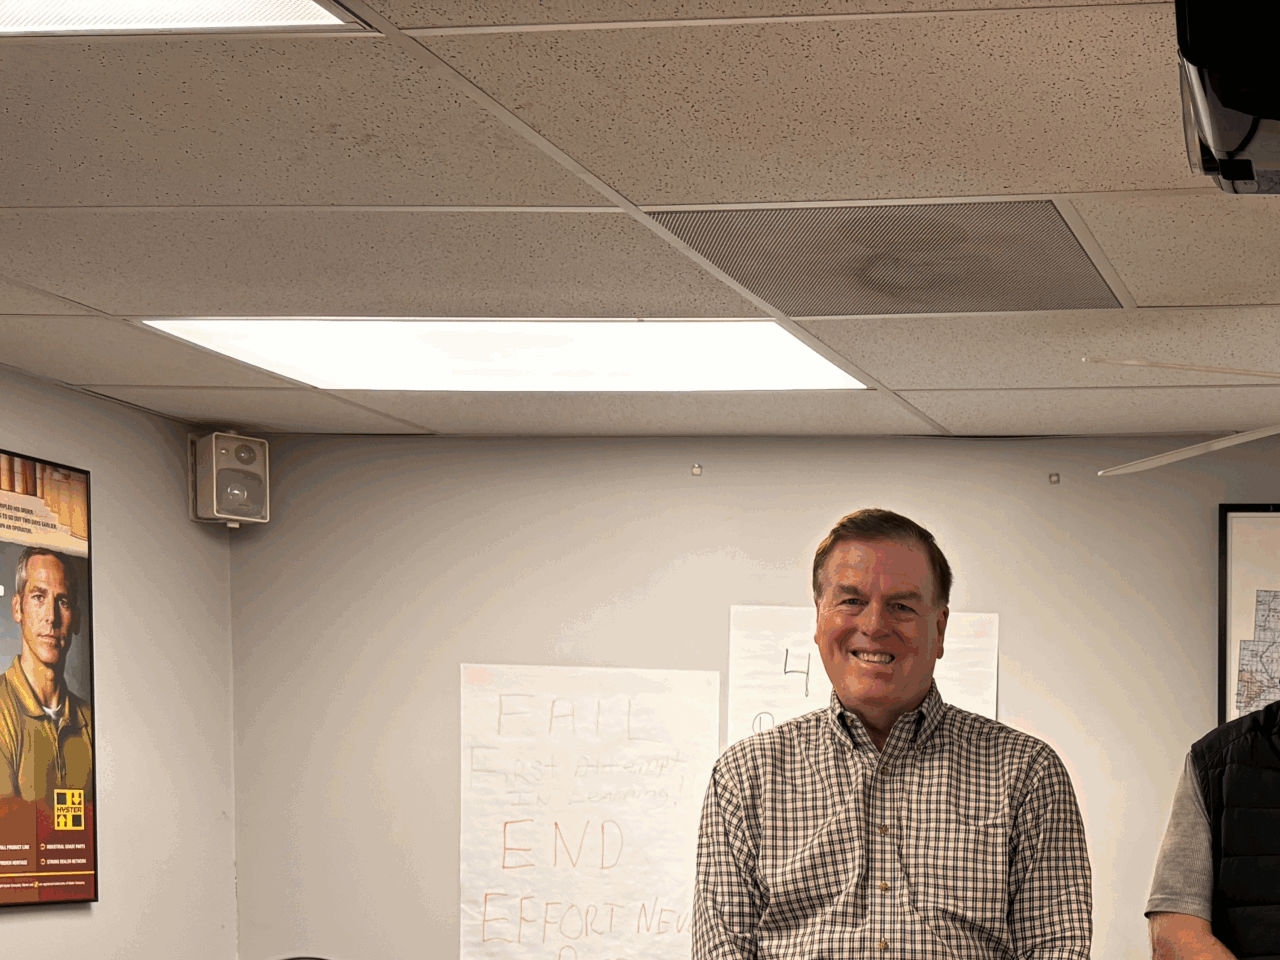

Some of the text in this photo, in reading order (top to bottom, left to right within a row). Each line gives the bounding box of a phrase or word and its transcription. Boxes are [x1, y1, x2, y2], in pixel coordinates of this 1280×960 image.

[783, 649, 812, 698] 4
[495, 692, 665, 742] FAIL
[501, 818, 624, 870] END
[481, 893, 627, 945] EFFORT
